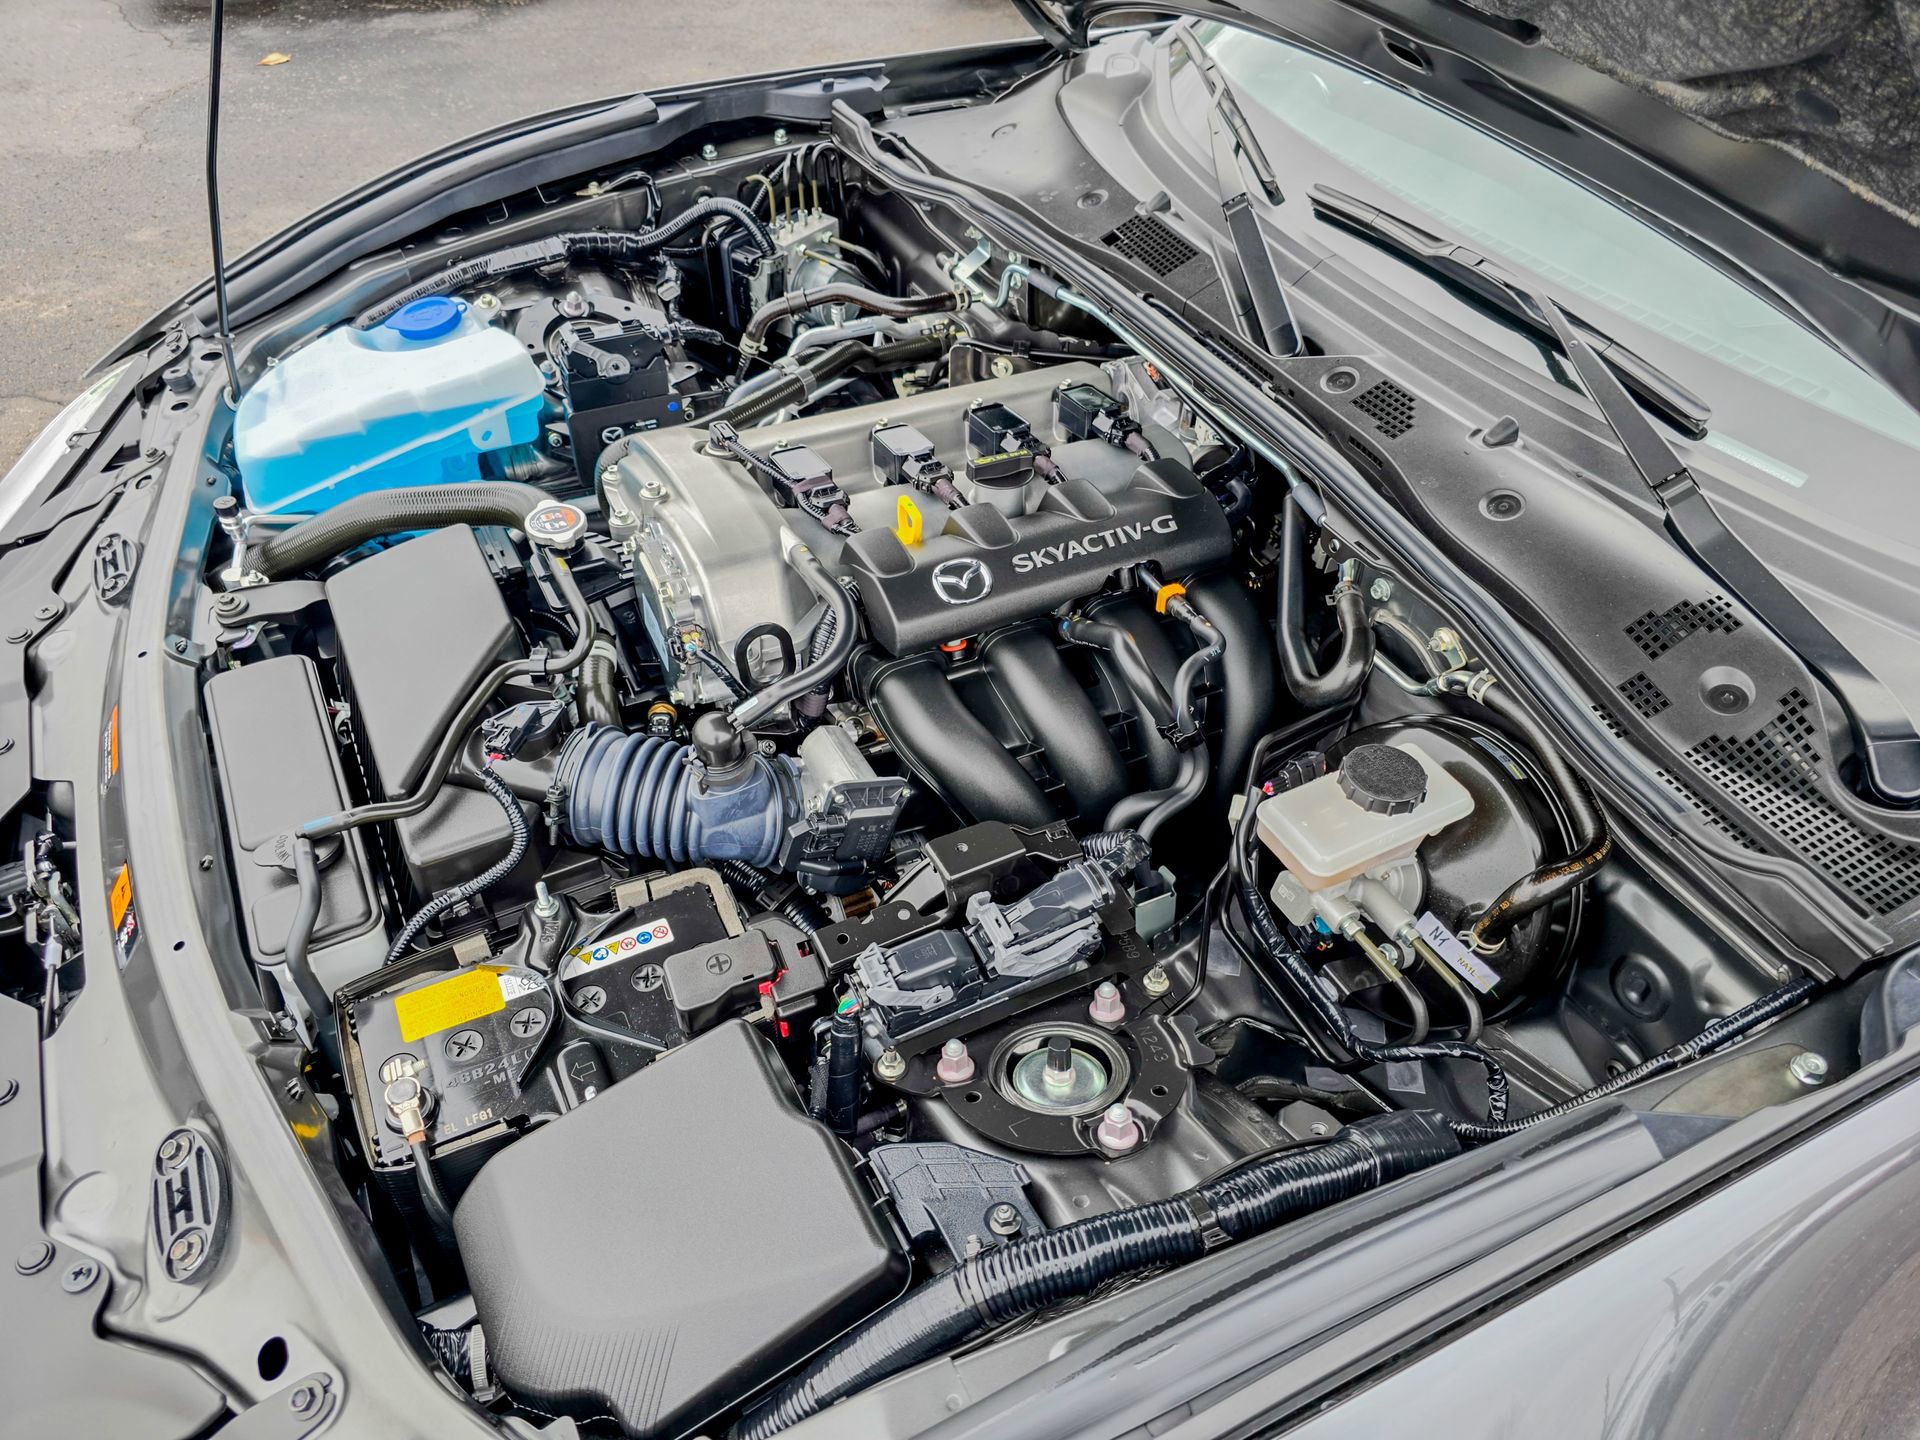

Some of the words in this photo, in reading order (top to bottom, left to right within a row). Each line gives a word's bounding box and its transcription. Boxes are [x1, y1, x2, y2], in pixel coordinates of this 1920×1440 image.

[1011, 514, 1178, 573] SKYACTIV-G
[1428, 925, 1449, 948] N1
[1139, 1026, 1169, 1063] N243
[443, 1123, 458, 1135] EL
